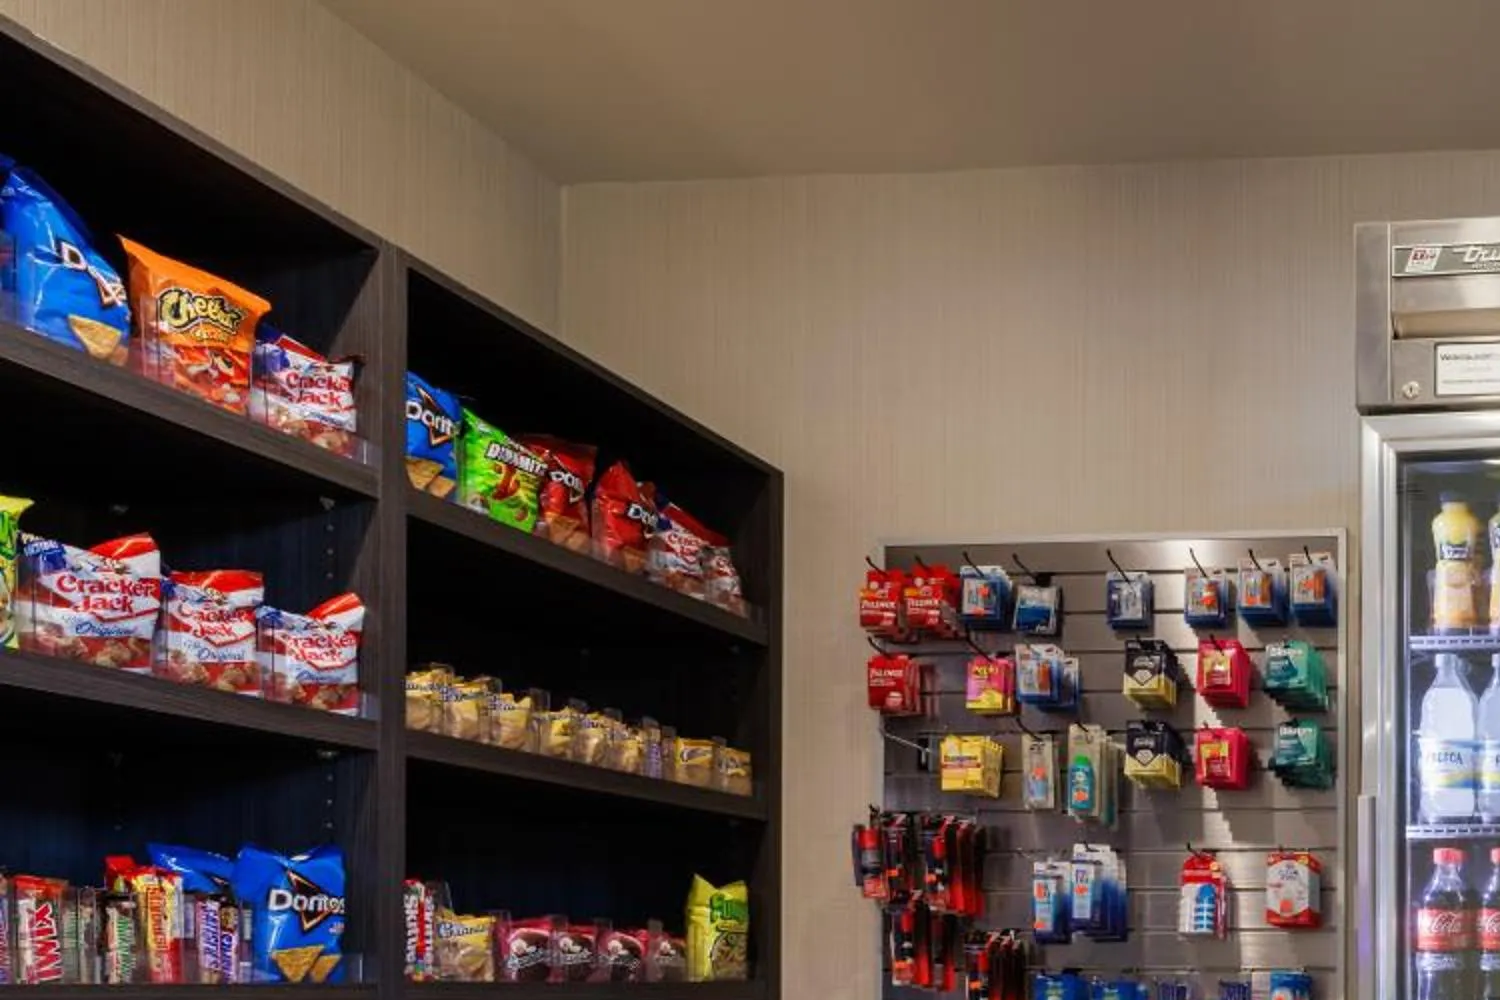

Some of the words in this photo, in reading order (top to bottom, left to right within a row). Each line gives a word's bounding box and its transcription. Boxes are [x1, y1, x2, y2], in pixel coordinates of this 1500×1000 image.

[56, 574, 154, 597] Cracker
[72, 594, 134, 613] Jack
[268, 888, 345, 914] Doritos
